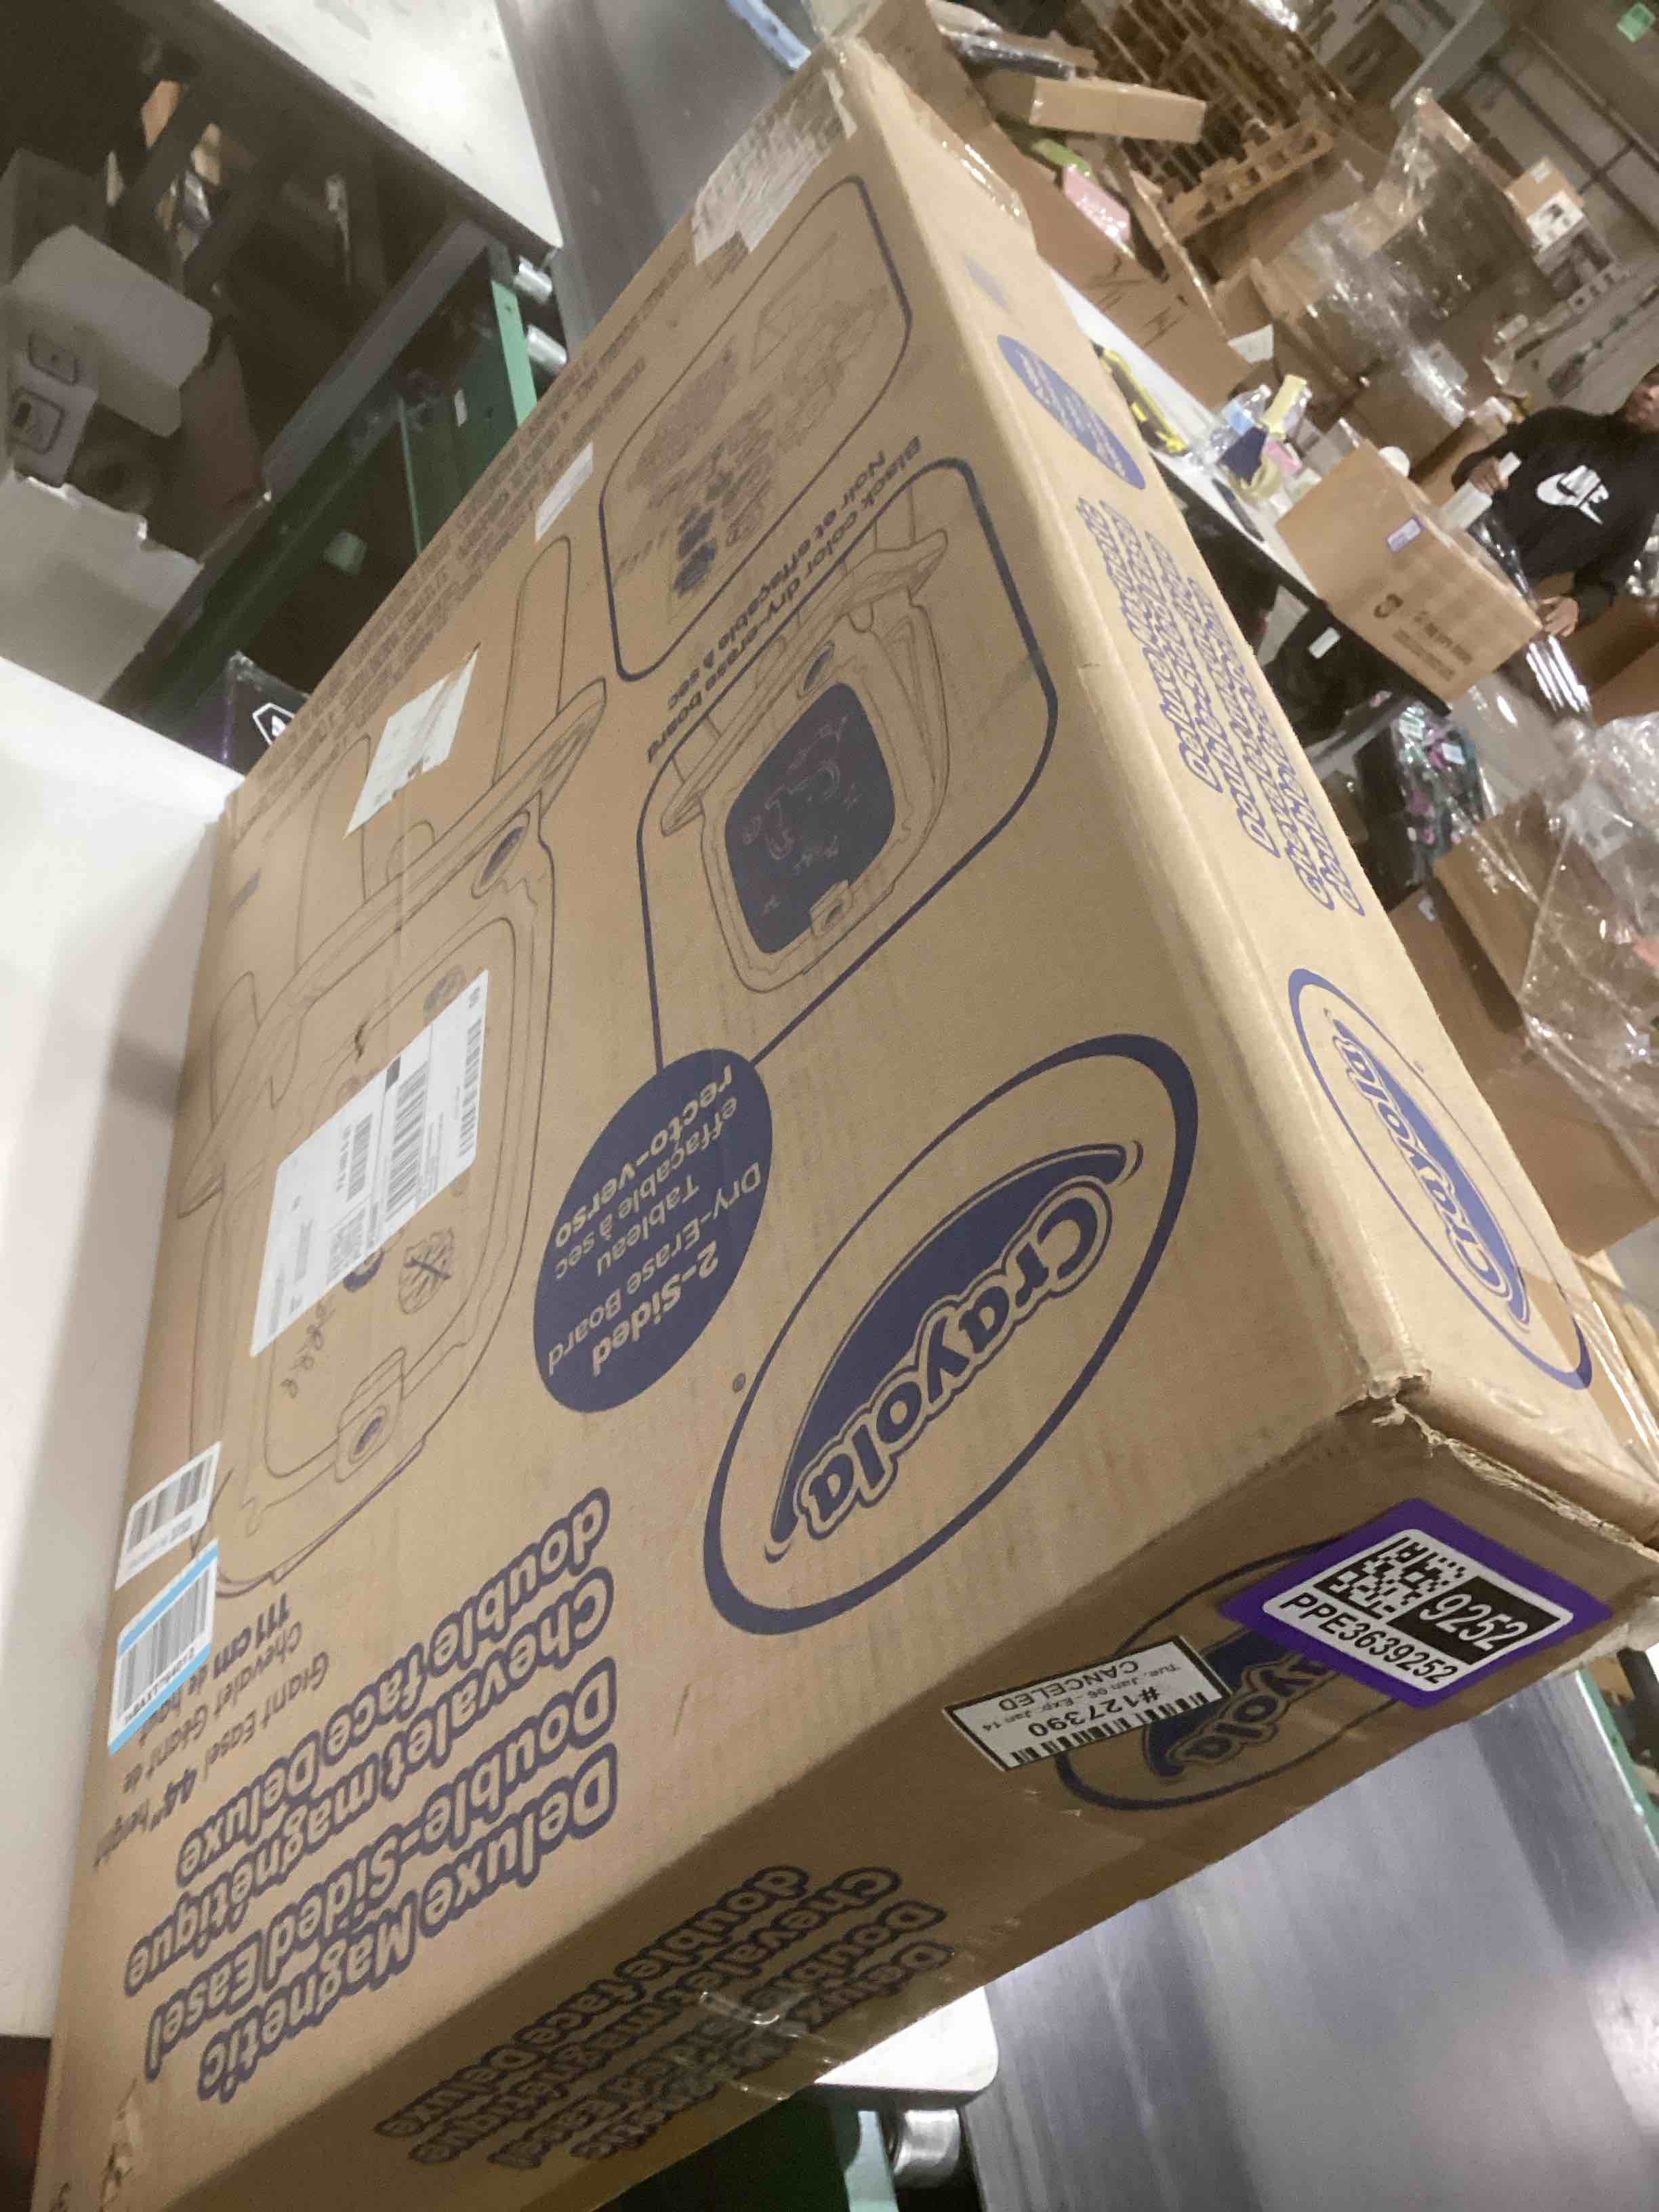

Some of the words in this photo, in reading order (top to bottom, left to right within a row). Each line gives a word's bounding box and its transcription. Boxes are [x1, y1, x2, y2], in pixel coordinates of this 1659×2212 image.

[813, 508, 840, 540] et
[838, 450, 890, 510] Noir
[860, 434, 927, 508] Black
[718, 537, 813, 659] effaçable
[805, 508, 862, 576] color
[704, 575, 802, 697] dry-erase
[1145, 647, 1221, 791] Deluxe
[553, 1062, 732, 1250] recto-verso
[617, 1094, 736, 1222] effaçable
[1335, 1036, 1509, 1300] Crayola
[553, 1229, 596, 1282] sec
[595, 1176, 699, 1278] Tableau
[598, 1212, 613, 1240] à
[625, 1158, 759, 1298] Dry-Erase
[546, 1287, 622, 1376] Board
[590, 1237, 718, 1379] 2-Sided
[801, 1185, 1109, 1536] Crayola
[428, 1487, 609, 1679] double
[1277, 1591, 1461, 1685] PPE3639252
[1413, 1589, 1532, 1652] 9252
[213, 1626, 253, 1679] cm
[214, 1621, 306, 1720] Chevalet
[262, 1651, 332, 1729] Giant
[321, 1639, 424, 1772] face
[382, 1565, 614, 1801] Chevalet
[995, 1659, 1142, 1713] CANCELED
[1109, 1676, 1141, 1690] Jan
[204, 1709, 258, 1784] Easel
[1003, 1710, 1035, 1724] Jan
[1025, 1686, 1162, 1738] #127390
[175, 1727, 321, 1889] Deluxe
[264, 1655, 614, 1991] Double-Sided
[423, 1743, 616, 1930] Deluxe
[123, 1753, 379, 1996] magnétique
[611, 1865, 811, 1988] double
[654, 1865, 903, 2012] Chevalet
[146, 1931, 260, 2081] Easel
[197, 1889, 414, 2102] Magnetic
[512, 1975, 644, 2050] face
[371, 2042, 546, 2141] Deluxe
